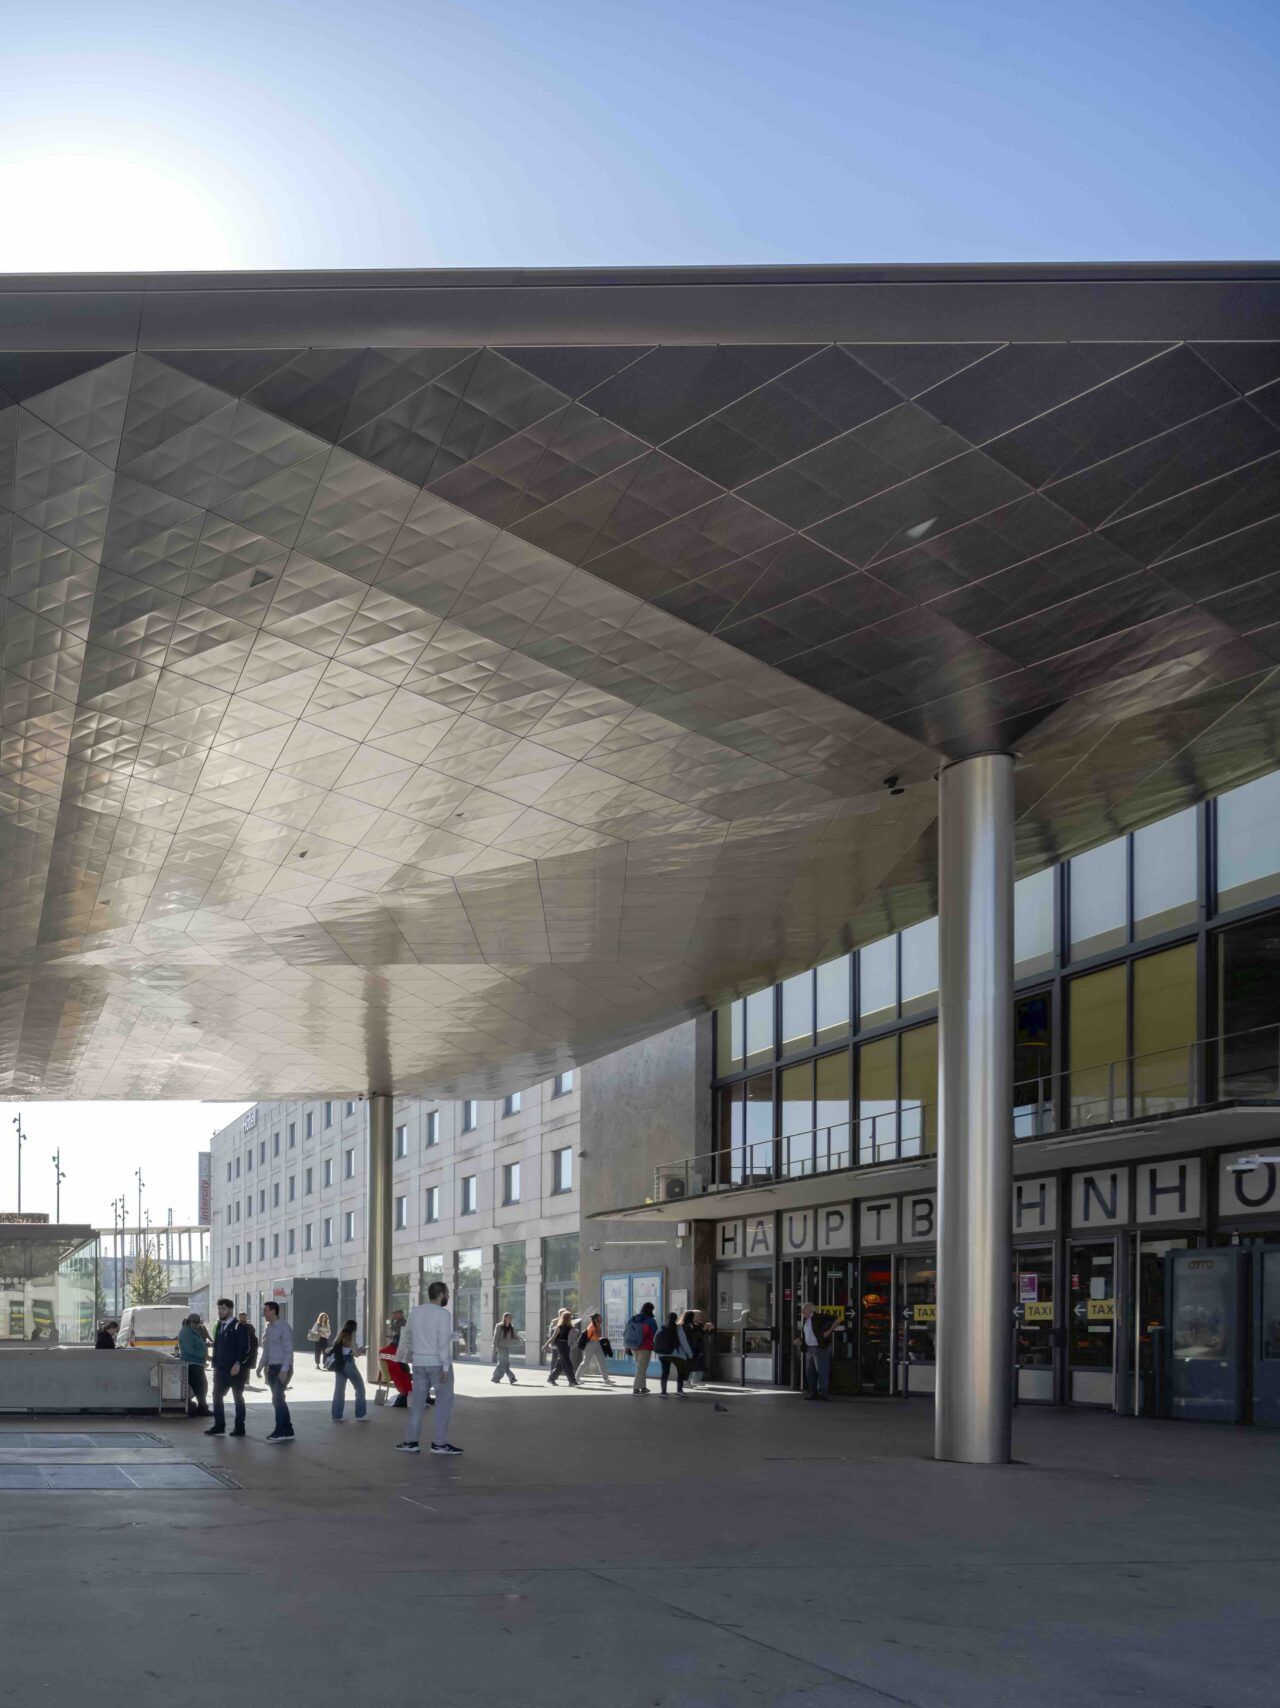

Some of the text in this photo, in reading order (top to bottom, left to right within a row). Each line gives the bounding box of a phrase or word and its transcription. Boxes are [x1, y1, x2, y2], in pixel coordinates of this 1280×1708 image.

[721, 1159, 1277, 1256] HAUPTBHNHO
[917, 1308, 936, 1317] TAX
[1028, 1306, 1052, 1316] TAXI
[1091, 1304, 1114, 1315] TAX
